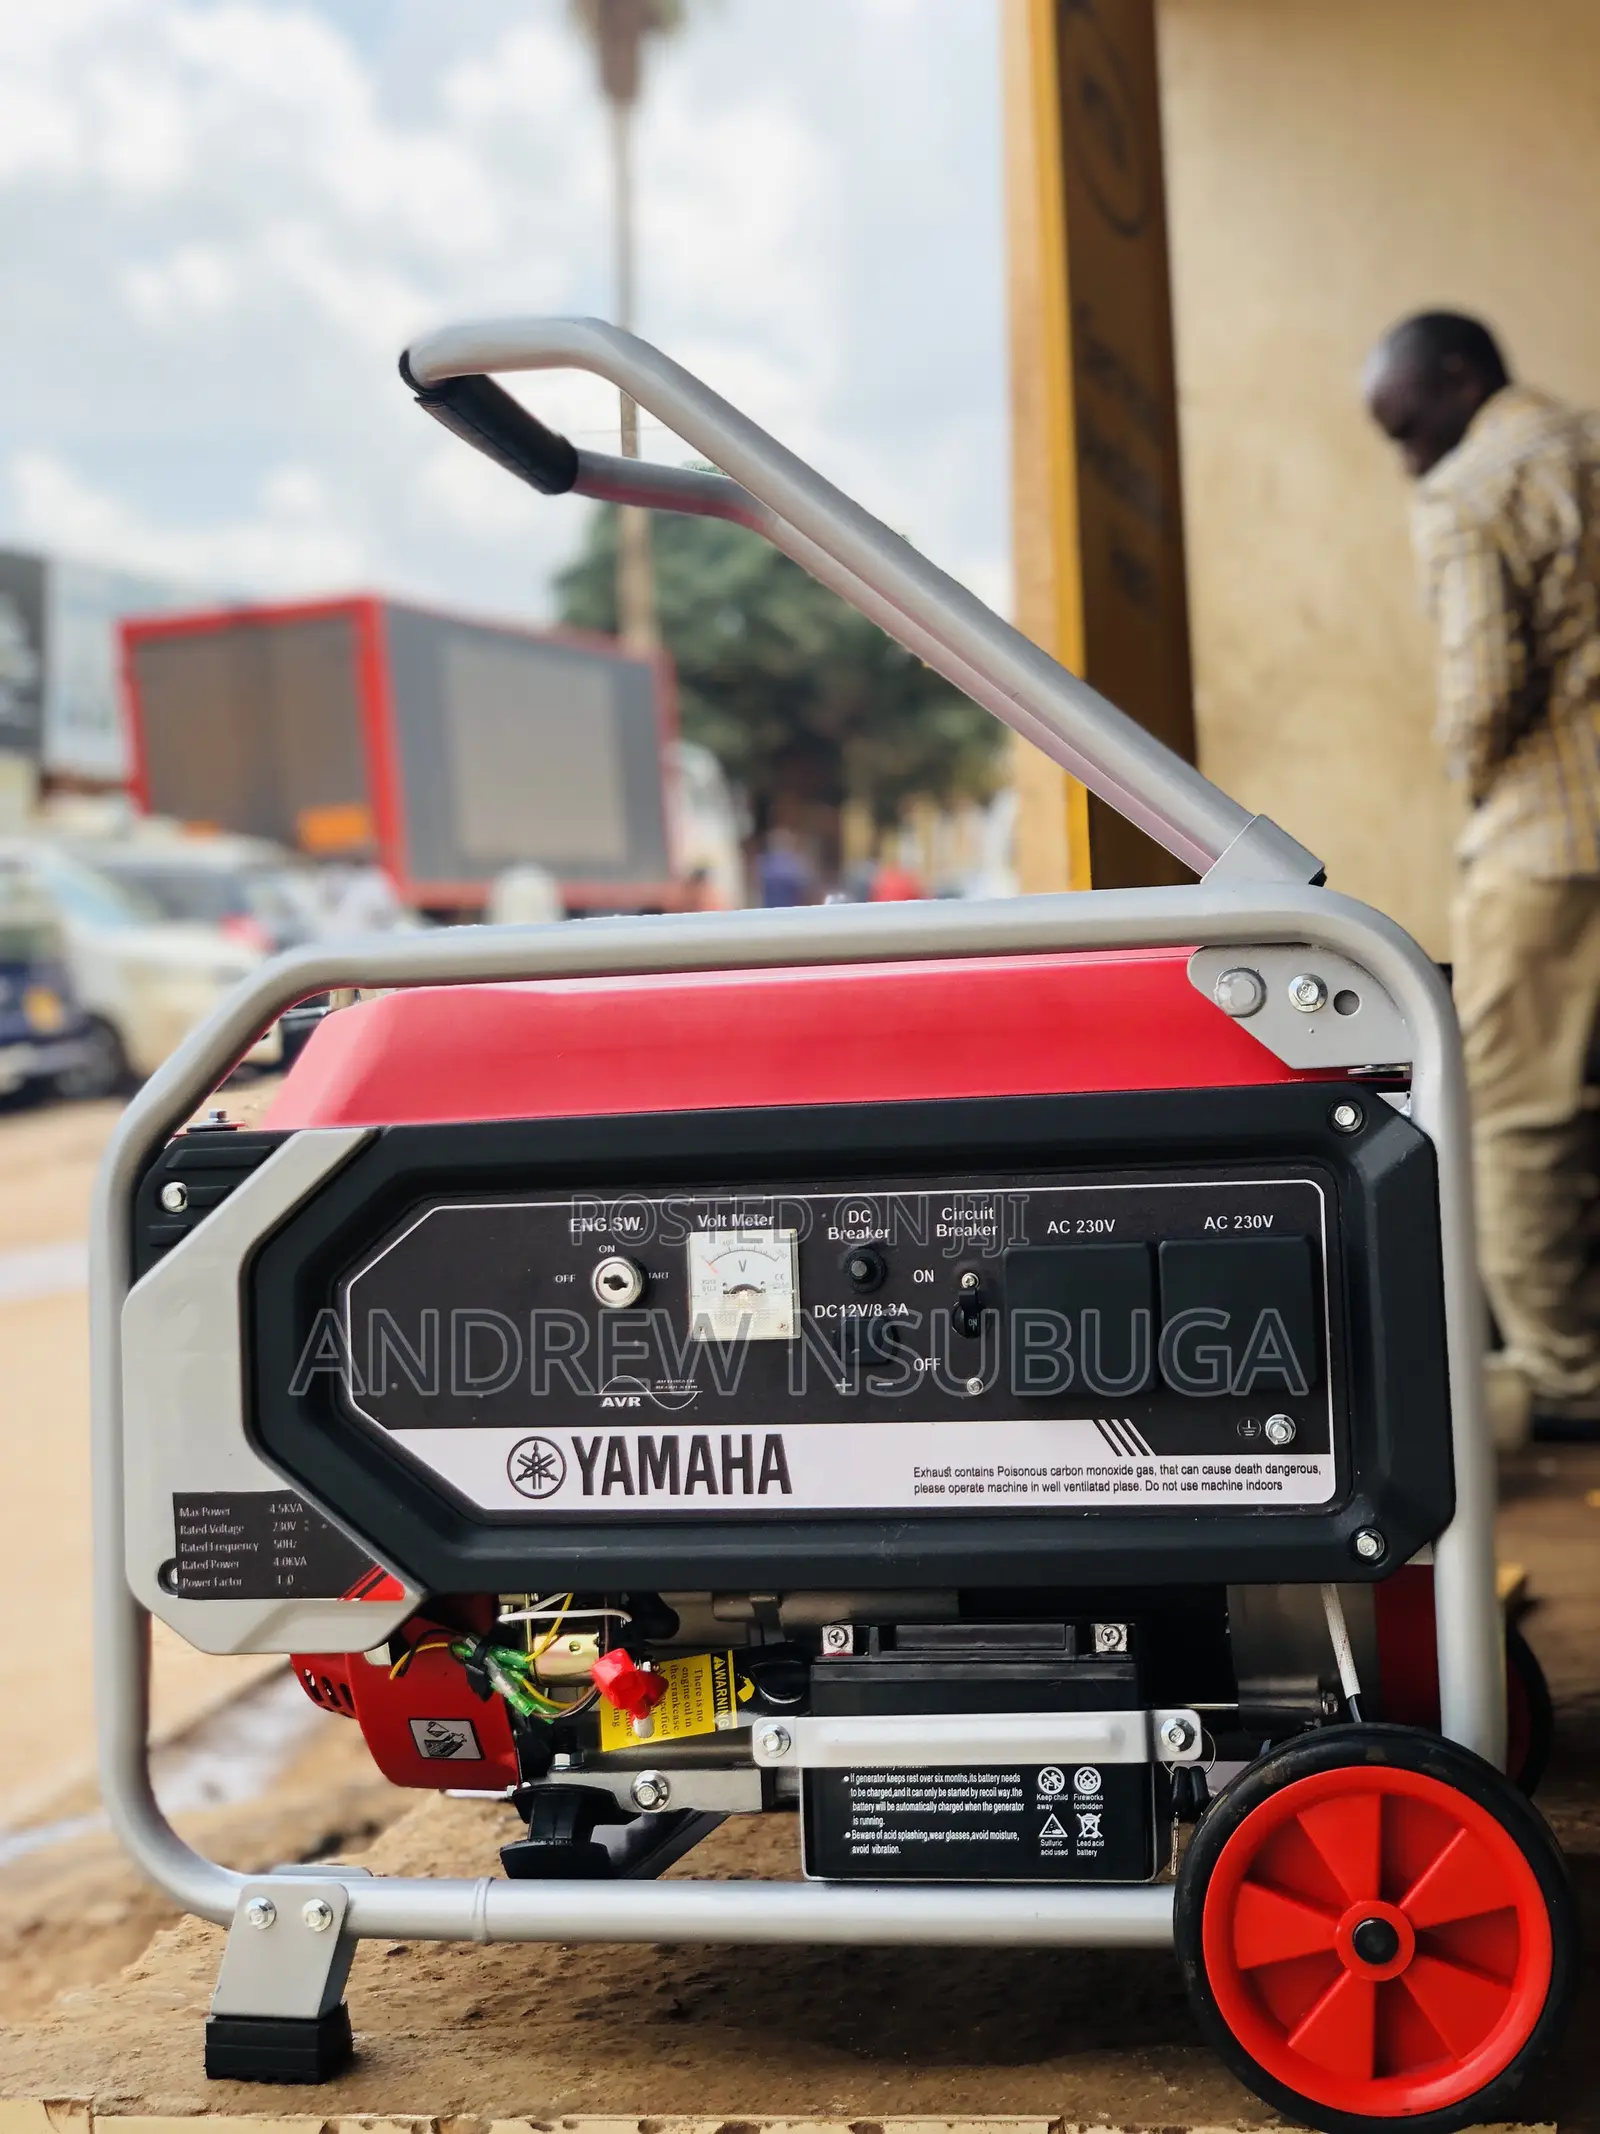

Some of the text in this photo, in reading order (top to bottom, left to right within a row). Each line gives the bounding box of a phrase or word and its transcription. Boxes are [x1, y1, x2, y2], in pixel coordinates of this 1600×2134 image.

[848, 1210, 871, 1223] DC
[941, 1207, 995, 1220] Circuit
[570, 1217, 644, 1232] ENG.SW.
[698, 1214, 775, 1228] Volt Meter
[1047, 1219, 1116, 1234] AC 230V
[1204, 1215, 1274, 1230] AC 230V
[828, 1226, 891, 1239] Breaker
[936, 1223, 998, 1237] Breaker
[599, 1244, 616, 1253] ON
[738, 1259, 747, 1272] V
[555, 1274, 576, 1283] OFF
[648, 1271, 670, 1280] TART
[913, 1269, 935, 1283] ON
[814, 1304, 909, 1318] DC12V/8.3A
[913, 1357, 941, 1371] OFF
[601, 1397, 641, 1407] AVR
[571, 1433, 792, 1495] YAMAHA
[914, 1463, 1321, 1478] Exhaust contains Poisonous carbon monoxide gas, that can cause death dangerous,
[914, 1483, 946, 1495] please
[948, 1483, 984, 1495] operate
[988, 1482, 1028, 1492] machine
[1031, 1482, 1040, 1492] in
[1042, 1481, 1061, 1492] well
[1113, 1480, 1142, 1494] plase.
[1145, 1480, 1160, 1491] Do
[1162, 1480, 1178, 1491] not
[1181, 1482, 1198, 1491] use
[1202, 1480, 1243, 1491] machine
[1246, 1479, 1283, 1490] indoors
[210, 1523, 244, 1536] Voltage
[670, 1664, 680, 1680] the
[694, 1668, 704, 1696] There
[680, 1666, 692, 1728] engine oil in
[714, 1668, 730, 1728] WARNING
[696, 1710, 704, 1722] no
[856, 1773, 887, 1785] generator
[886, 1773, 906, 1785] keeps
[906, 1773, 919, 1783] rest
[919, 1775, 934, 1783] over
[934, 1773, 944, 1783] six
[978, 1773, 1000, 1785] battery
[1001, 1773, 1020, 1783] needs
[850, 1787, 857, 1797] to
[857, 1787, 866, 1797] be
[906, 1787, 911, 1797] it
[911, 1789, 923, 1797] can
[924, 1787, 938, 1799] only
[938, 1787, 947, 1797] be
[947, 1787, 970, 1797] started
[970, 1787, 979, 1799] by
[979, 1787, 997, 1797] recoil
[852, 1801, 1024, 1813] battery will be automatically charged when the generator
[853, 1816, 885, 1827] is running.
[851, 1830, 876, 1840] Beware
[876, 1830, 883, 1840] of
[883, 1830, 897, 1840] acid
[990, 1830, 1020, 1842] moisture,
[852, 1844, 901, 1854] avoid vibration.
